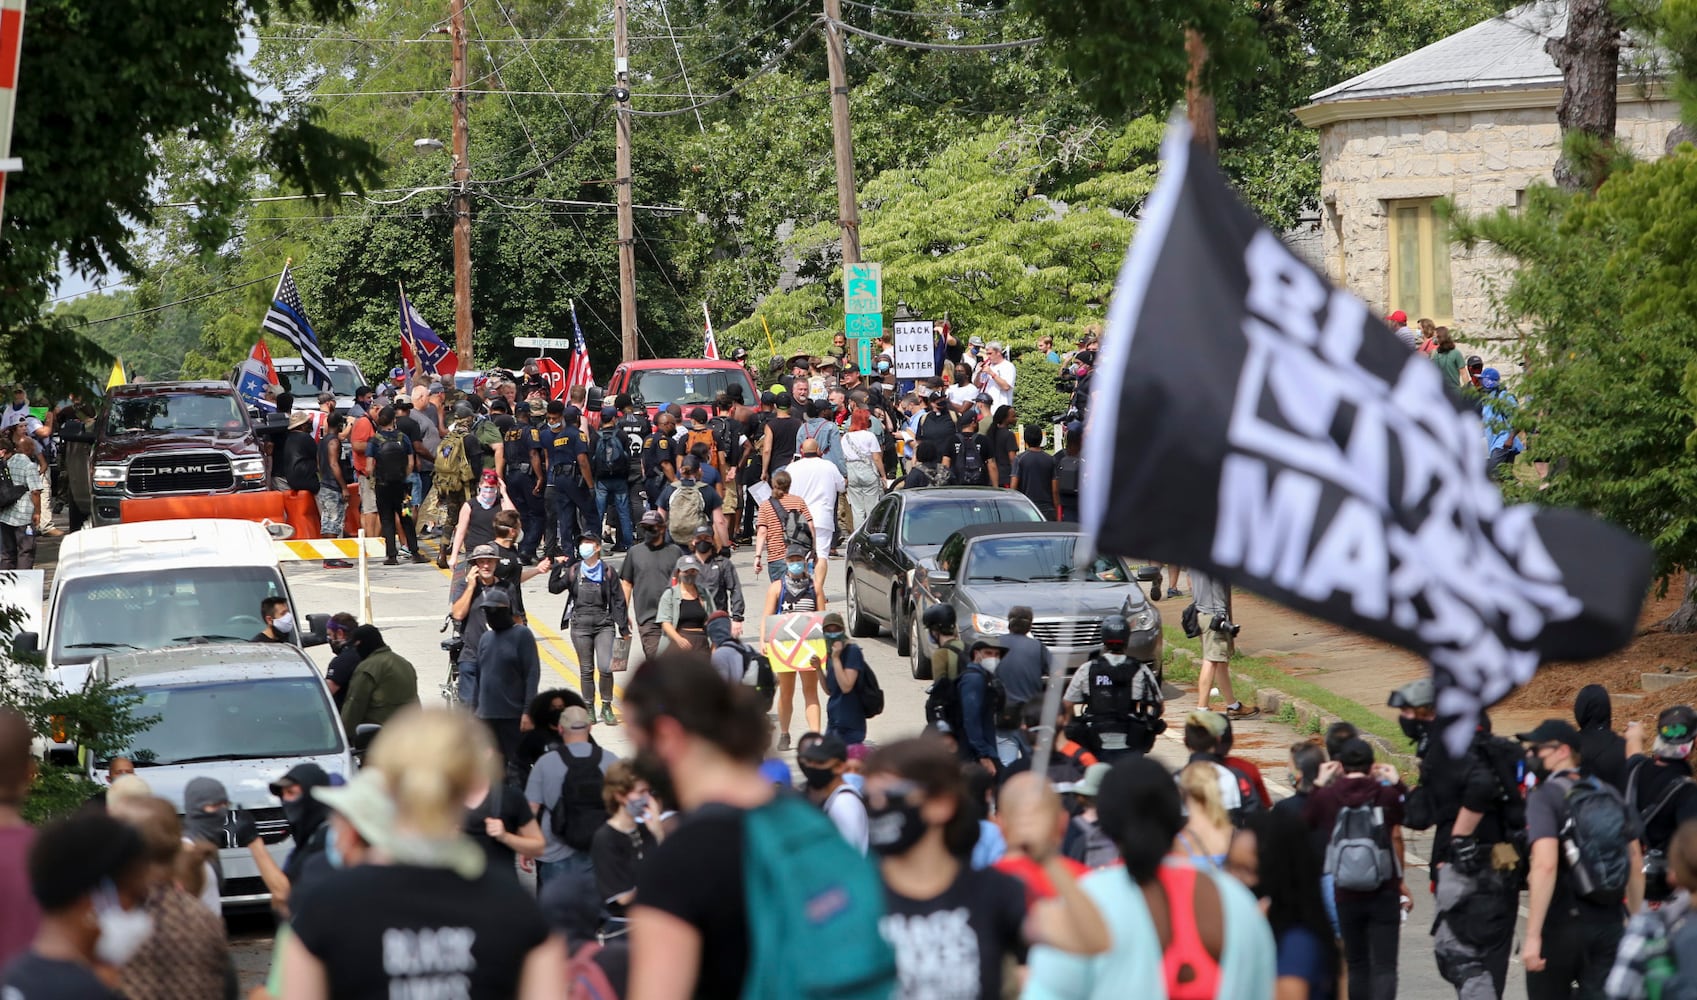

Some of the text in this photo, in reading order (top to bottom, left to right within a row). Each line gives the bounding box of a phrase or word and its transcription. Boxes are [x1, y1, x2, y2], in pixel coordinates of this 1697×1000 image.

[896, 326, 930, 335] BLACK
[899, 344, 928, 352] LIVES
[896, 361, 933, 370] MATTER
[158, 465, 201, 474] RAM
